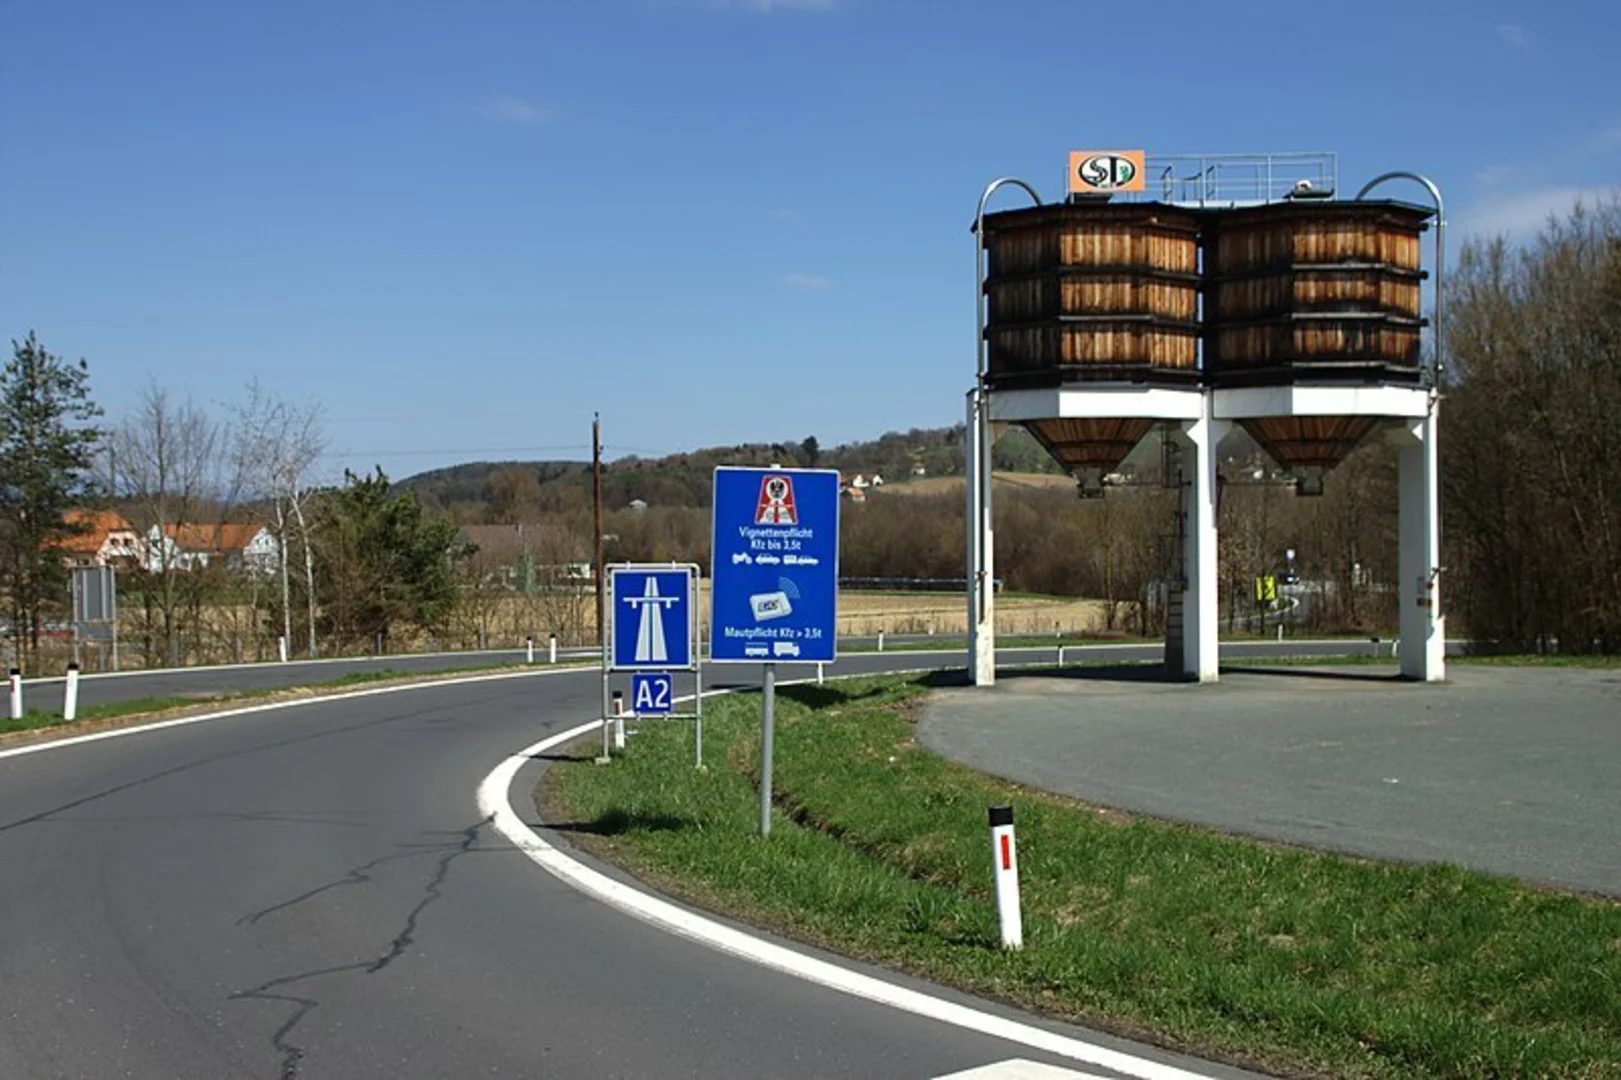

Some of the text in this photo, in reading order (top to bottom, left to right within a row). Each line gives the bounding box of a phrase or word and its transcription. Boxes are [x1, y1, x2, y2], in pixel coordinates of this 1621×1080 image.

[739, 526, 813, 540] Vignettenpflicht
[751, 539, 766, 550] Kfz
[767, 539, 781, 550] bis
[724, 626, 778, 639] Mautpflicht
[780, 627, 795, 638] Kfz
[636, 679, 669, 708] A2
